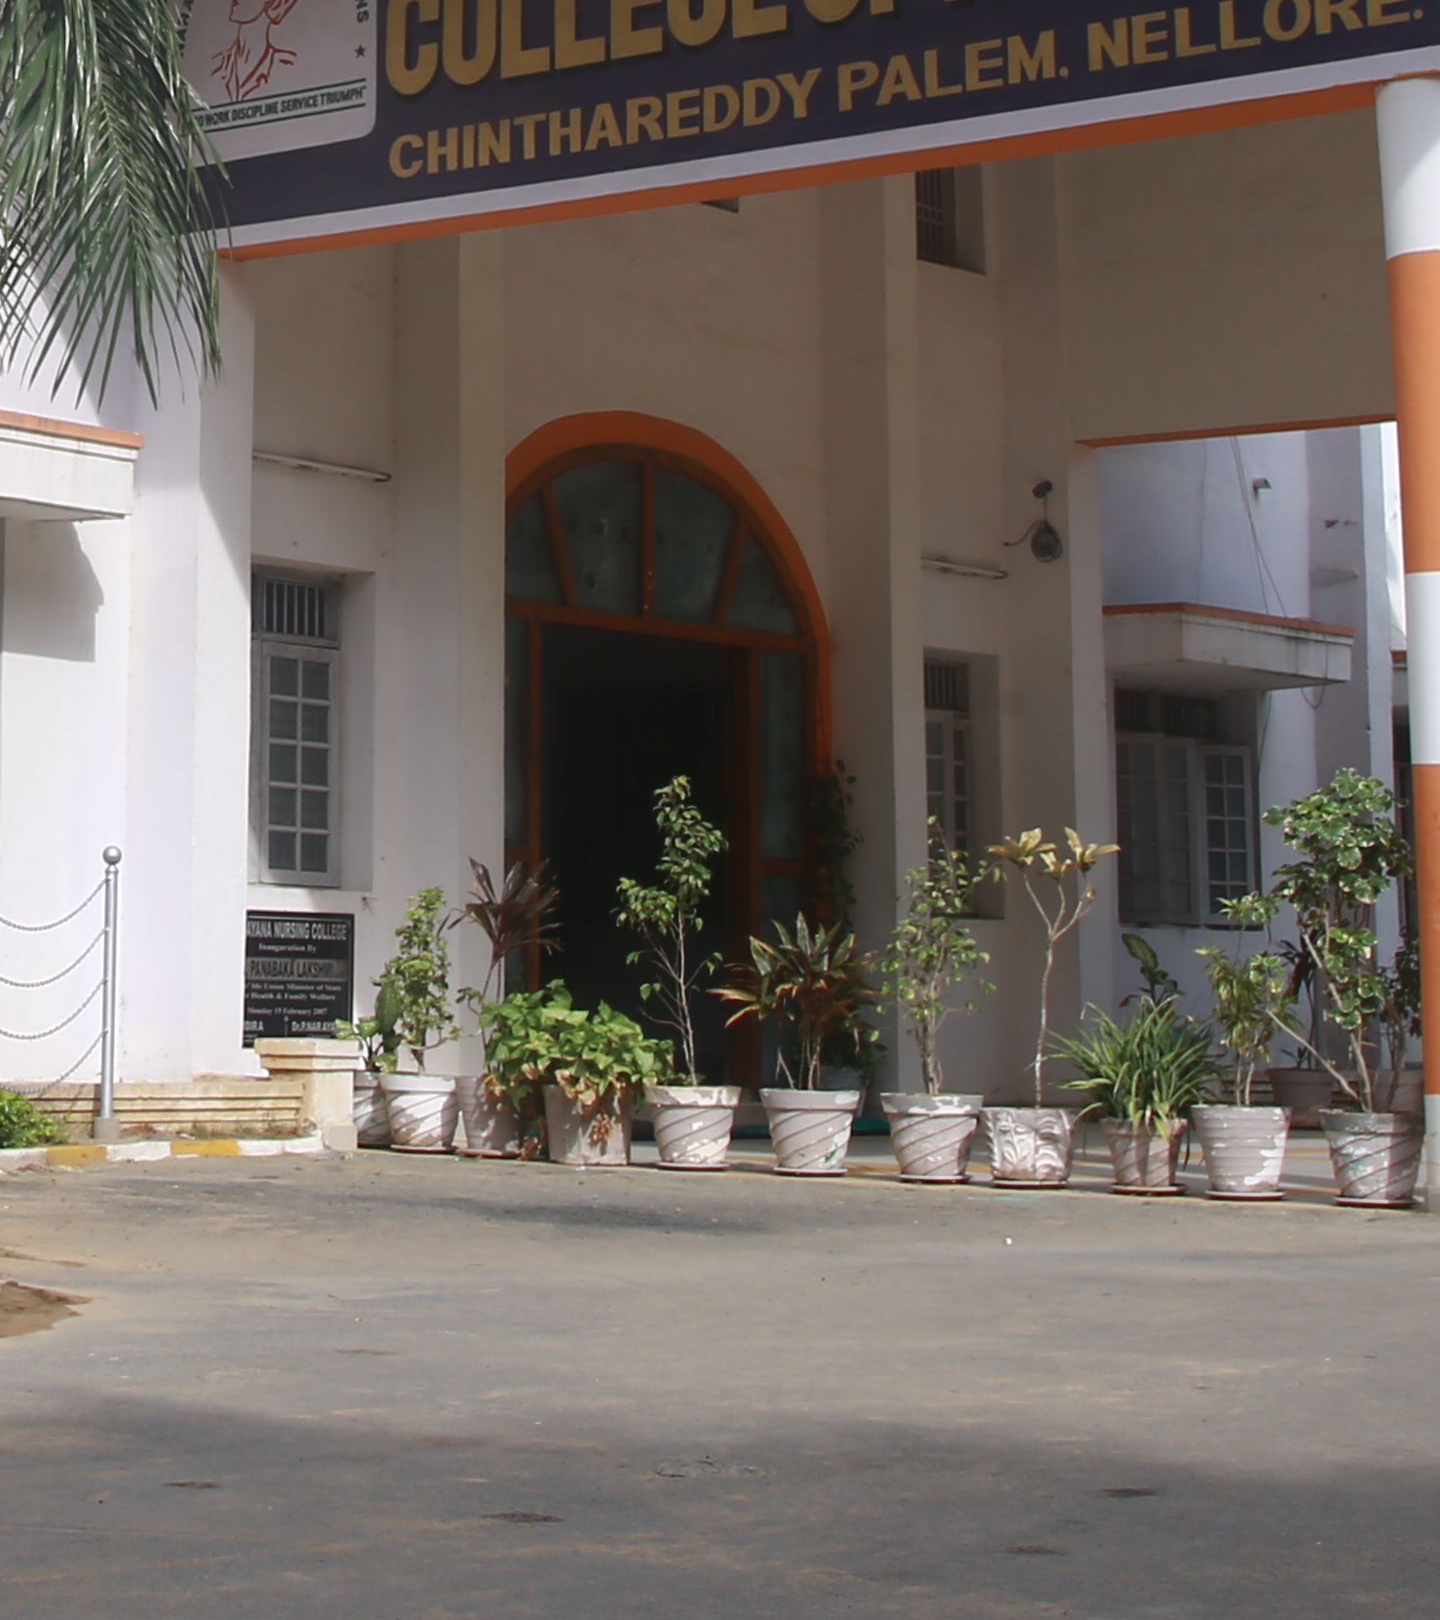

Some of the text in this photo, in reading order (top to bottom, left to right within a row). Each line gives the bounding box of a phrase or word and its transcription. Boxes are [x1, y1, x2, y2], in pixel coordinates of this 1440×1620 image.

[205, 110, 233, 126] WORK
[232, 102, 280, 121] DISCIPLINE
[280, 95, 319, 114] SERVICE
[389, 67, 822, 179] CHINTHAREDDY
[273, 922, 310, 939] NURSING
[311, 922, 347, 940] COLLEGE
